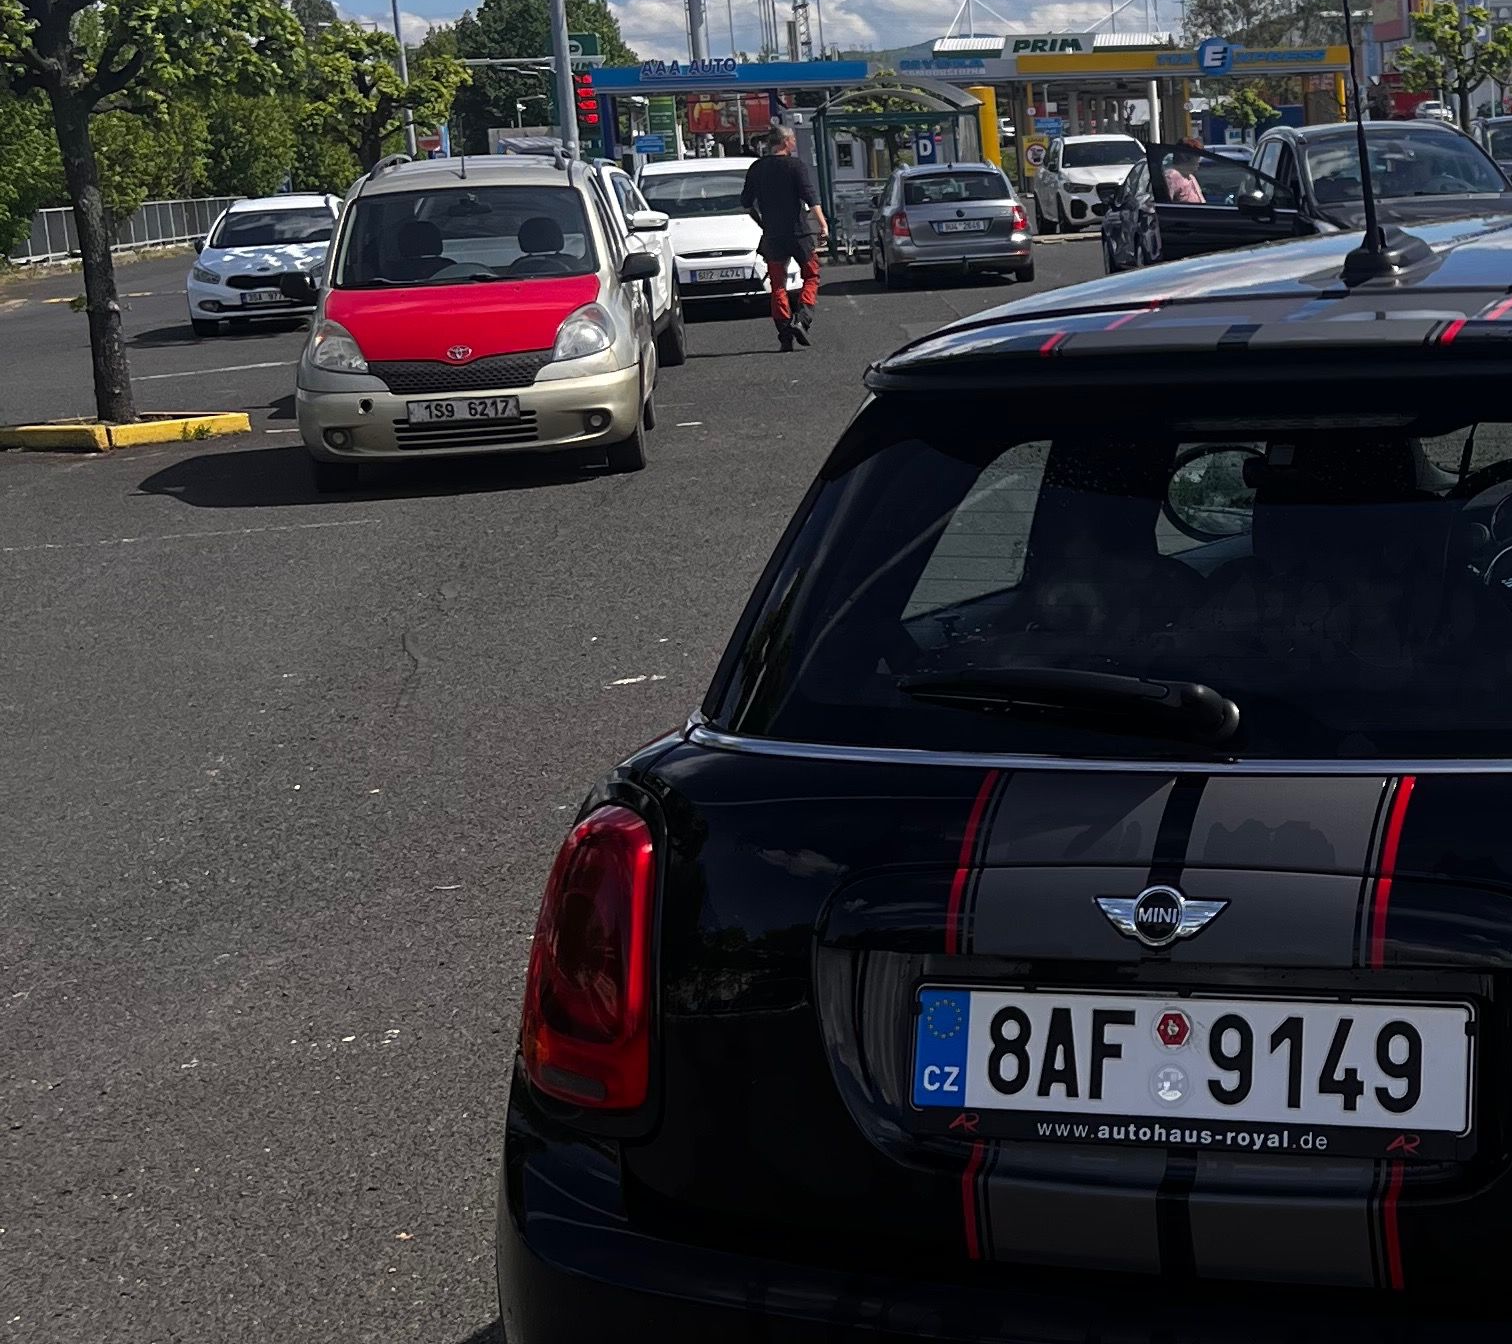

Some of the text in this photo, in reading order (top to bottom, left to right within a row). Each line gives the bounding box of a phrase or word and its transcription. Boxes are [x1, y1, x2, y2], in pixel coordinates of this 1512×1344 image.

[1013, 38, 1083, 53] PRIM
[640, 57, 738, 74] AAA AUTO
[425, 399, 509, 419] 1S9 6217
[1138, 907, 1177, 924] MINI
[987, 1005, 1423, 1114] 8AF 9149
[922, 1064, 960, 1093] CZ
[1036, 1119, 1328, 1152] www.autohaus-royal.de
